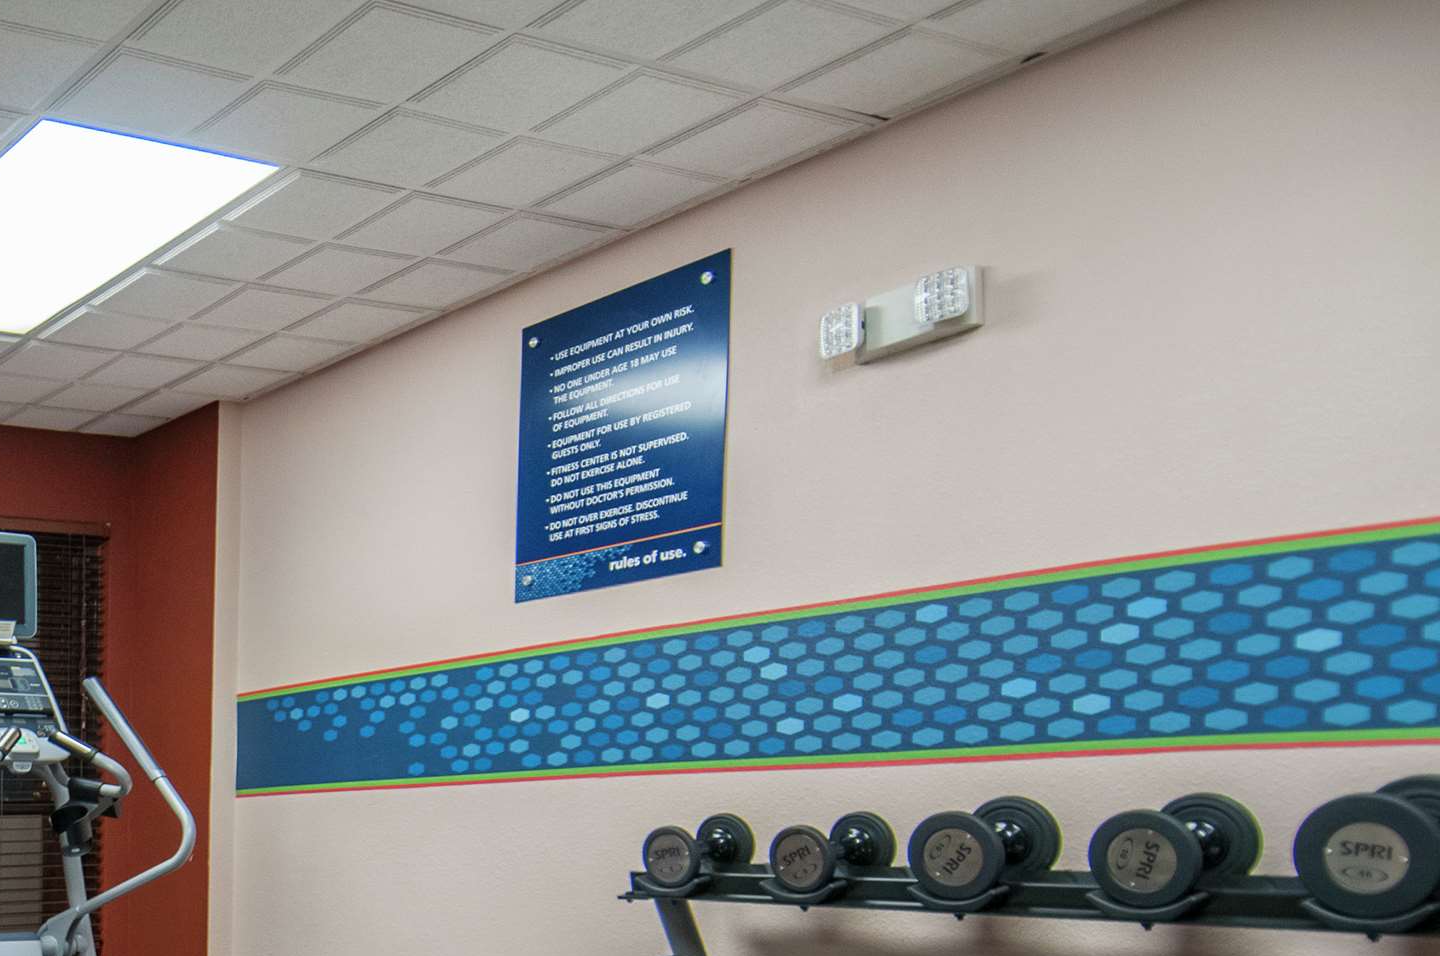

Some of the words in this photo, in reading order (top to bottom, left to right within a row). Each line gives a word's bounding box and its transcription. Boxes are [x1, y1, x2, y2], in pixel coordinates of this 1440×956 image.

[554, 359, 591, 377] IMPROPER
[592, 354, 606, 364] USE
[607, 346, 623, 359] CAN
[625, 336, 652, 352] RESULT
[654, 334, 662, 343] IN
[664, 322, 694, 338] INJURY.
[555, 350, 568, 361] USE
[569, 333, 613, 355] EQUIPMENT
[614, 329, 625, 340] AT
[626, 321, 650, 334] YOUR
[651, 312, 672, 326] OWN
[674, 305, 695, 318] RISK.
[553, 383, 566, 393] NO
[567, 377, 582, 389] ONE
[584, 368, 610, 383] UNDER
[611, 362, 628, 374] AGE
[630, 359, 639, 368] 18
[640, 352, 660, 365] MAY
[661, 345, 678, 358] USE
[552, 405, 584, 421] FOLLOW
[585, 401, 599, 411] ALL
[646, 380, 663, 392] FOR
[664, 374, 680, 386] USE
[553, 393, 568, 404] THE
[552, 429, 595, 449] EQUIPMENT
[596, 424, 612, 436] FOR
[613, 419, 628, 430] USE
[629, 415, 641, 426] BY
[642, 401, 692, 422] REGISTERED
[552, 423, 563, 432] OF
[551, 461, 580, 476] FITNESS
[580, 453, 610, 468] CENTER
[610, 451, 618, 459] IS
[619, 445, 638, 458] NOT
[639, 431, 689, 453] SUPERVISED.
[552, 445, 579, 459] GUESTS
[550, 477, 563, 487] DO
[564, 472, 580, 483] NOT
[581, 463, 615, 479] EXERCISE
[616, 456, 646, 470] ALONE.
[550, 494, 563, 504] DO
[563, 489, 579, 500] NOT
[580, 485, 594, 495] USE
[596, 481, 613, 492] THIS
[614, 468, 661, 487] EQUIPMENT
[549, 521, 561, 531] DO
[562, 517, 577, 527] NOT
[578, 511, 599, 523] OVER
[635, 490, 688, 511] DISCONTINUE
[550, 500, 585, 514] WITHOUT
[625, 477, 675, 497] PERMISSION.
[549, 533, 563, 542] USE
[564, 529, 574, 539] AT
[575, 524, 595, 536] FIRST
[595, 519, 617, 532] SIGNS
[618, 516, 630, 526] OF
[631, 510, 660, 524] STRESS.
[608, 556, 641, 571] rules
[642, 549, 659, 564] of
[660, 548, 687, 562] use.
[655, 846, 680, 860] SPRI
[783, 845, 811, 867] SPRI
[943, 843, 972, 875] SPRI
[1136, 840, 1161, 880] SPRI
[1341, 841, 1393, 860] SPRI
